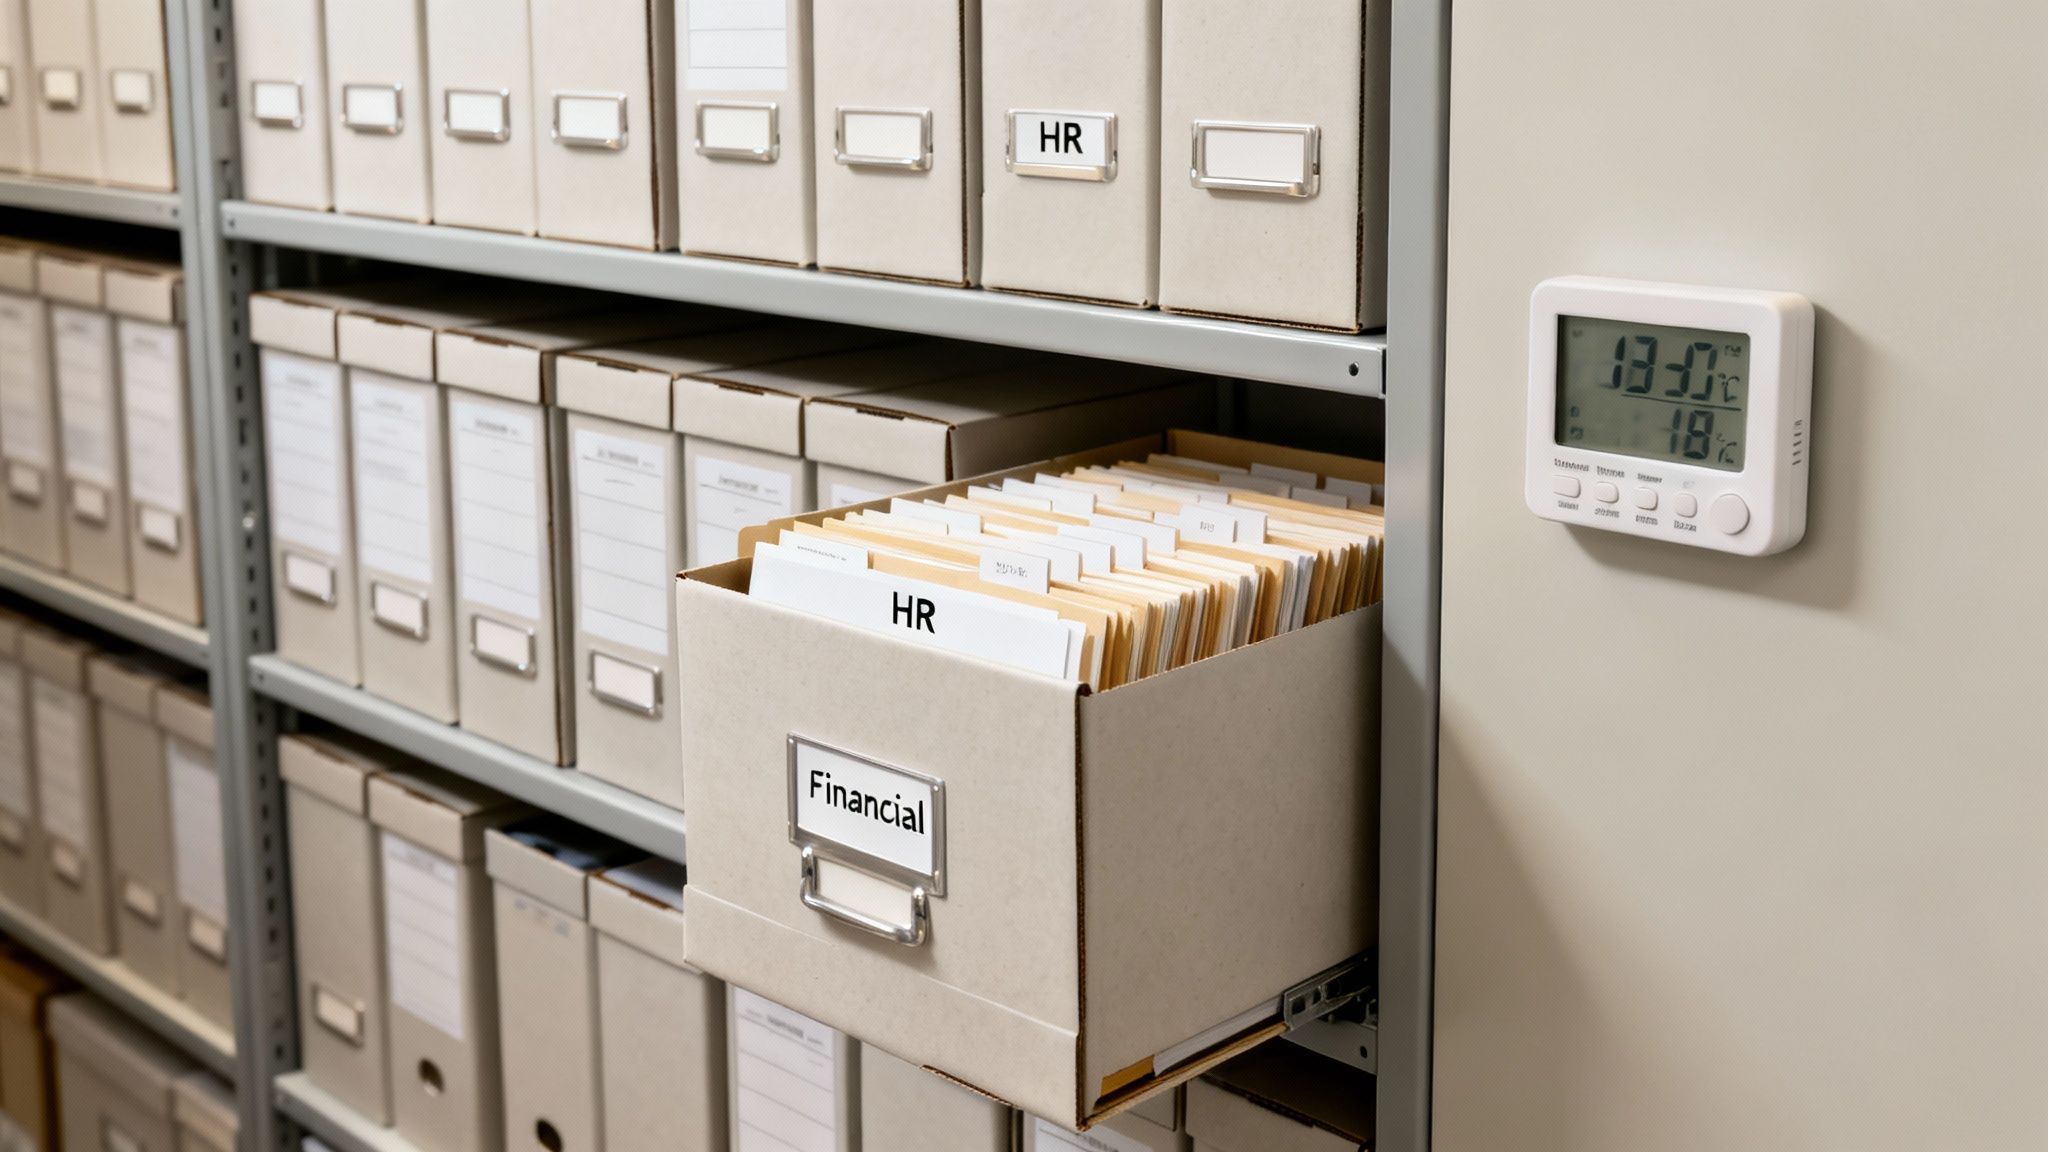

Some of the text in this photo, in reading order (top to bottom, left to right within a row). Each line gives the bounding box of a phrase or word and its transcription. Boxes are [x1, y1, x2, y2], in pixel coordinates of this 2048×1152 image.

[1040, 121, 1083, 154] HR
[1669, 408, 1715, 460] 18
[892, 591, 936, 634] HR
[809, 769, 925, 835] Financial
